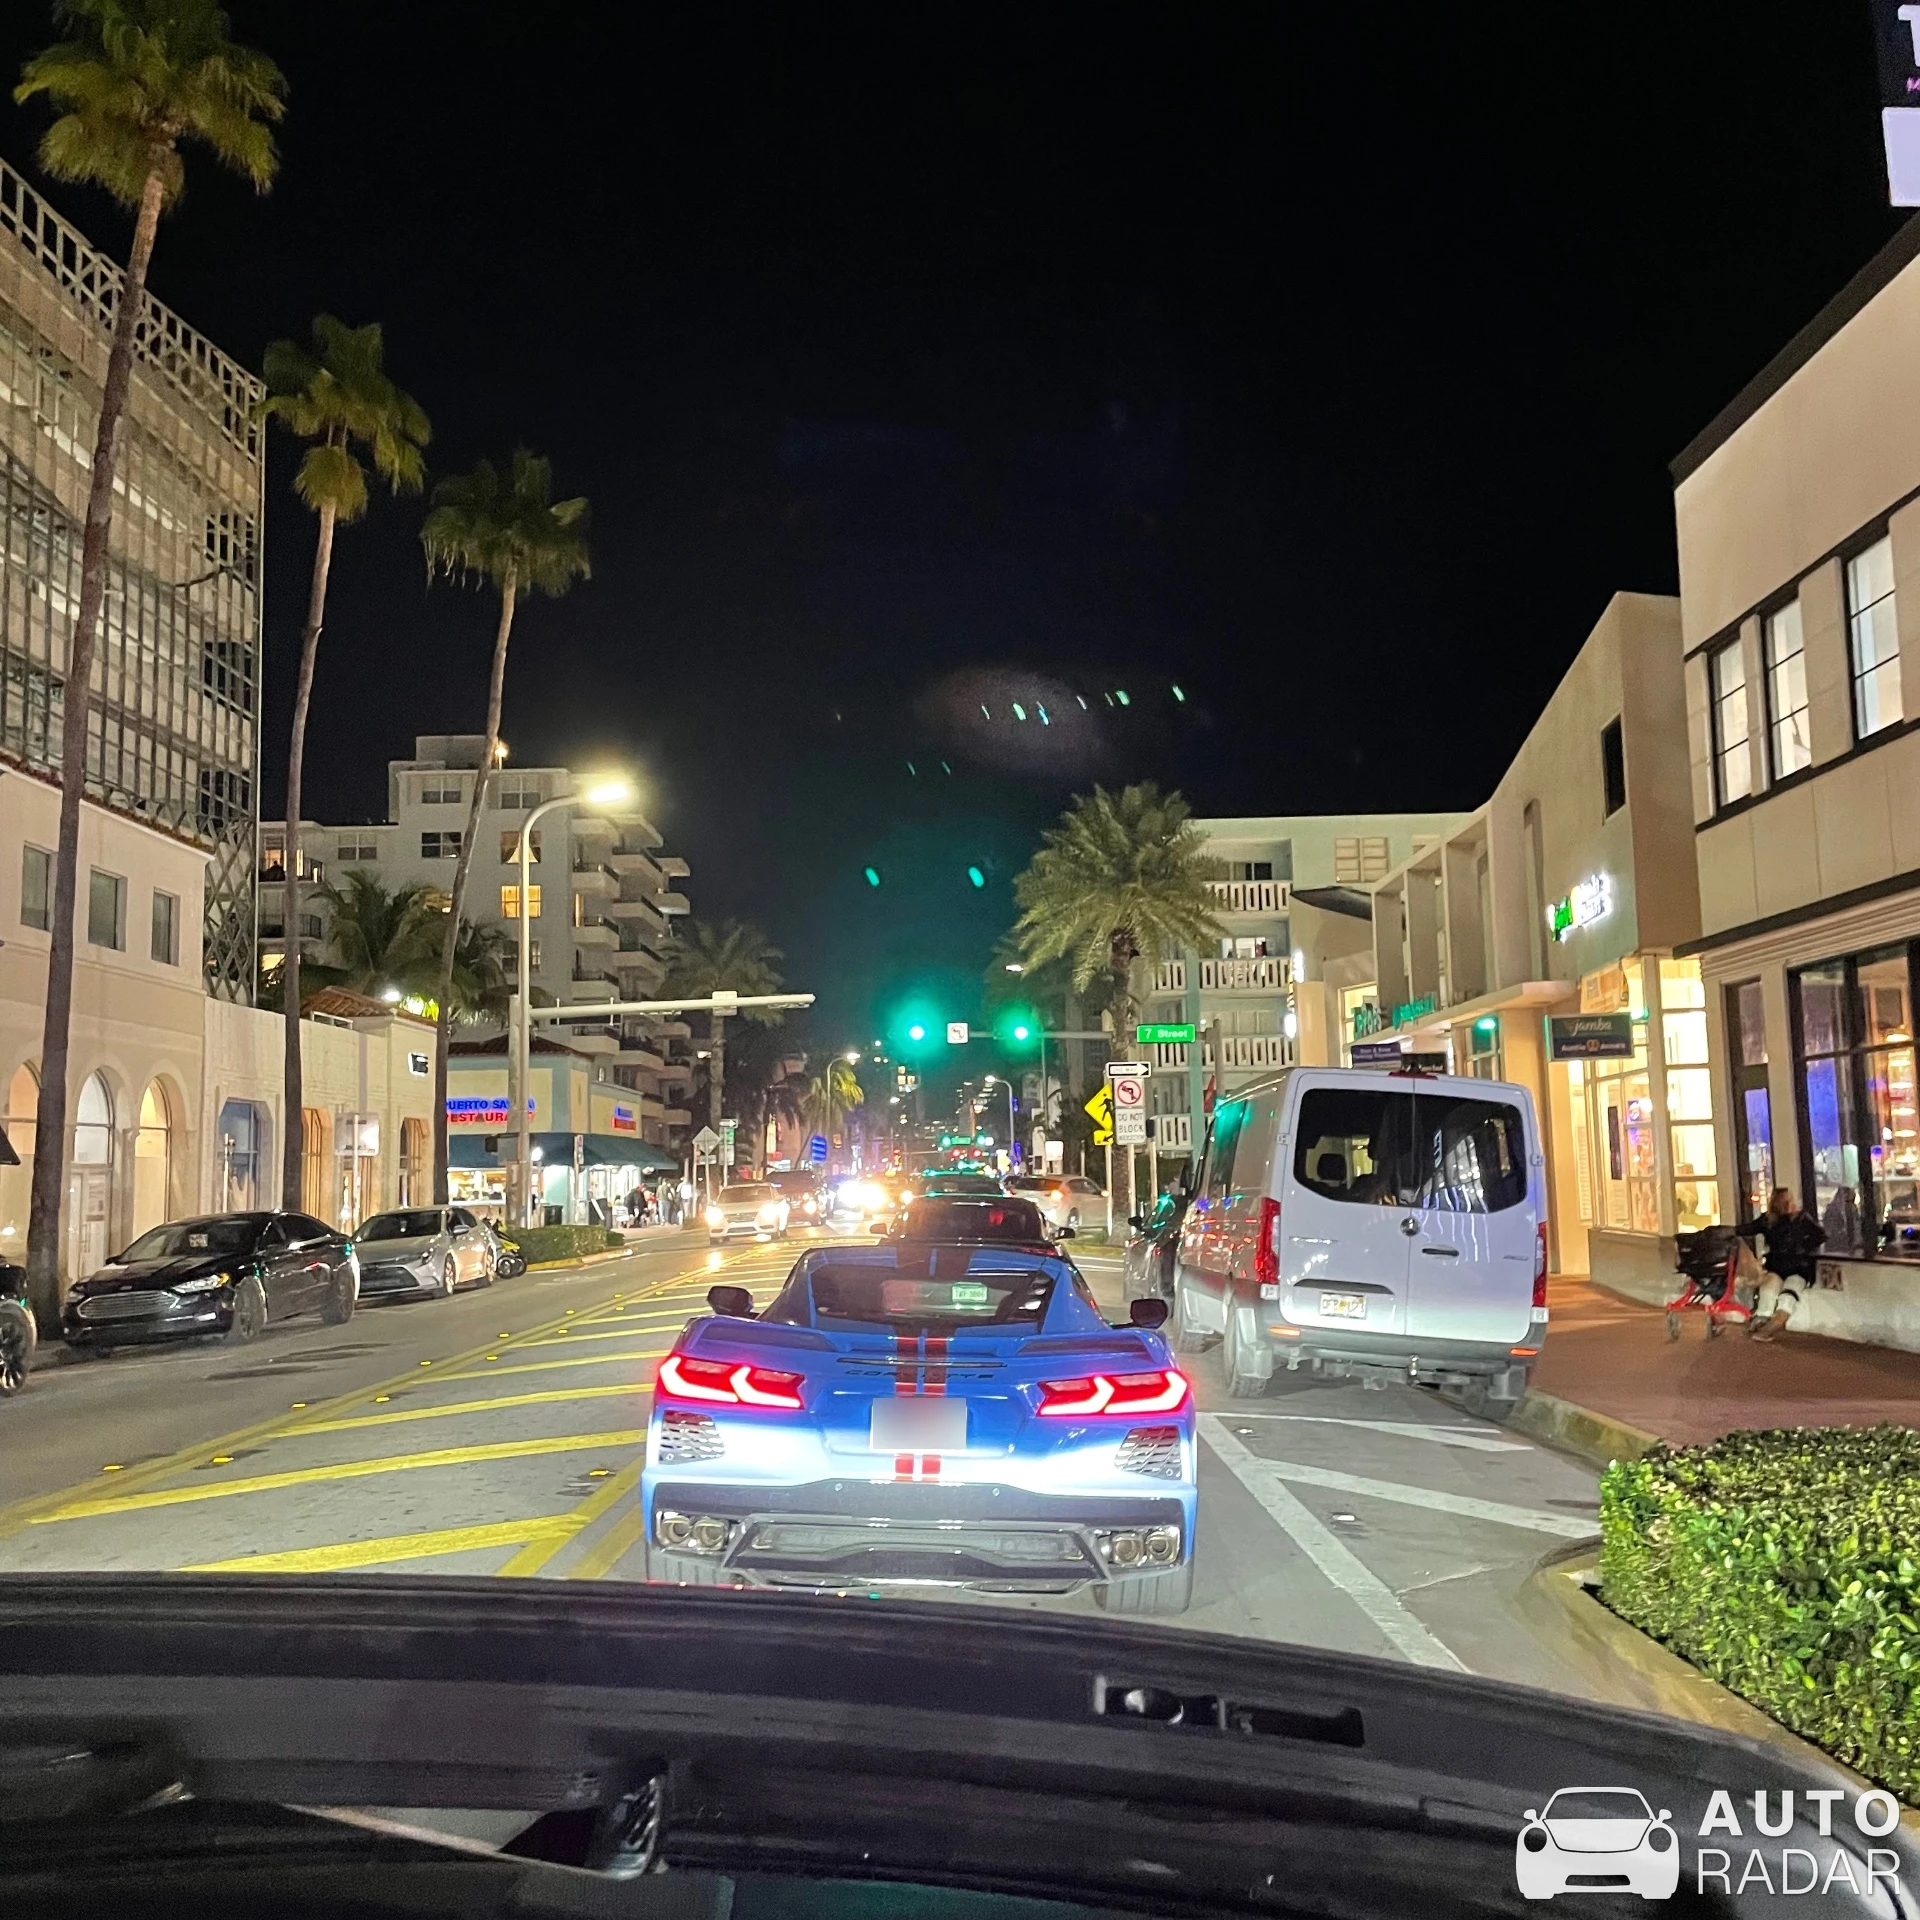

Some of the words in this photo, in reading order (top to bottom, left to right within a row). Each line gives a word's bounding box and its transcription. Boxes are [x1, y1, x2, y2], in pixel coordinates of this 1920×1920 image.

[1572, 1018, 1612, 1037] jamba
[1144, 1028, 1153, 1039] 7
[1157, 1029, 1188, 1039] Street
[446, 1111, 534, 1122] ESTAUR
[1118, 1113, 1128, 1121] DO
[1129, 1112, 1143, 1121] NOT
[1118, 1124, 1144, 1133] BLOCK
[845, 1369, 995, 1379] CORTTE
